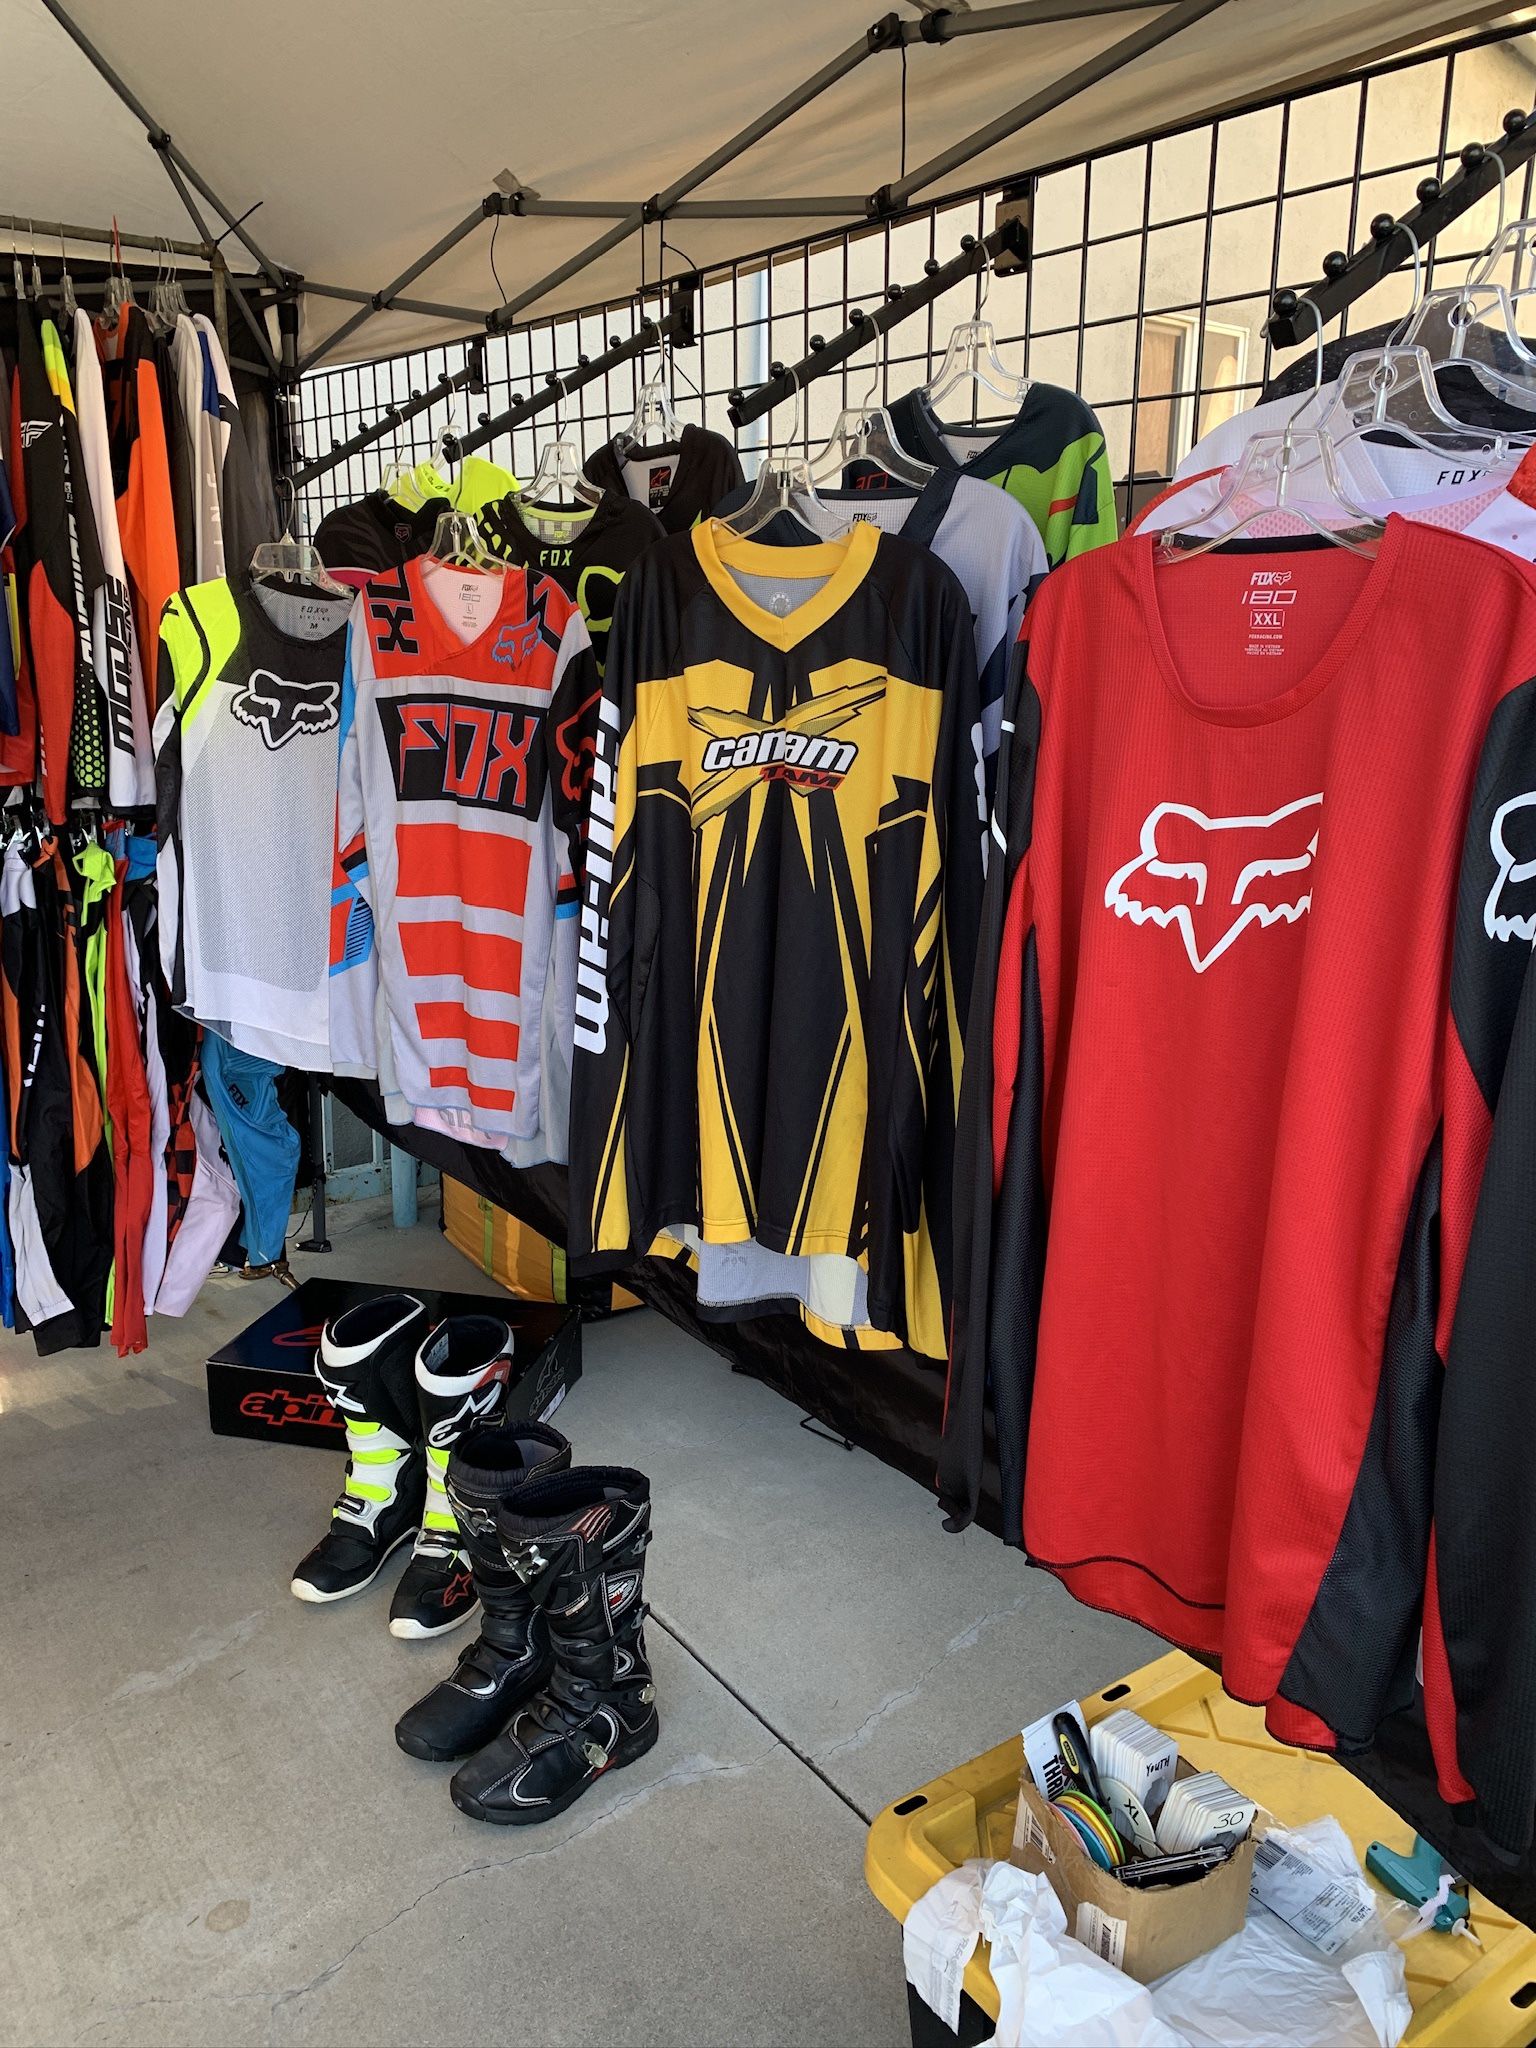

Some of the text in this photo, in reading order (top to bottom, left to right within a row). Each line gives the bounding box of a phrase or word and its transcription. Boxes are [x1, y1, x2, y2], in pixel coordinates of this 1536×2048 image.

[1437, 469, 1482, 486] FOX
[540, 549, 573, 567] FOX
[1250, 572, 1276, 585] FOX
[1241, 590, 1297, 604] 180
[1253, 612, 1281, 625] XXL
[103, 573, 136, 758] MOOSE
[397, 703, 540, 808] FOX
[228, 1083, 249, 1109] FOX
[1123, 1798, 1139, 1826] XL
[1213, 1811, 1244, 1829] 30
